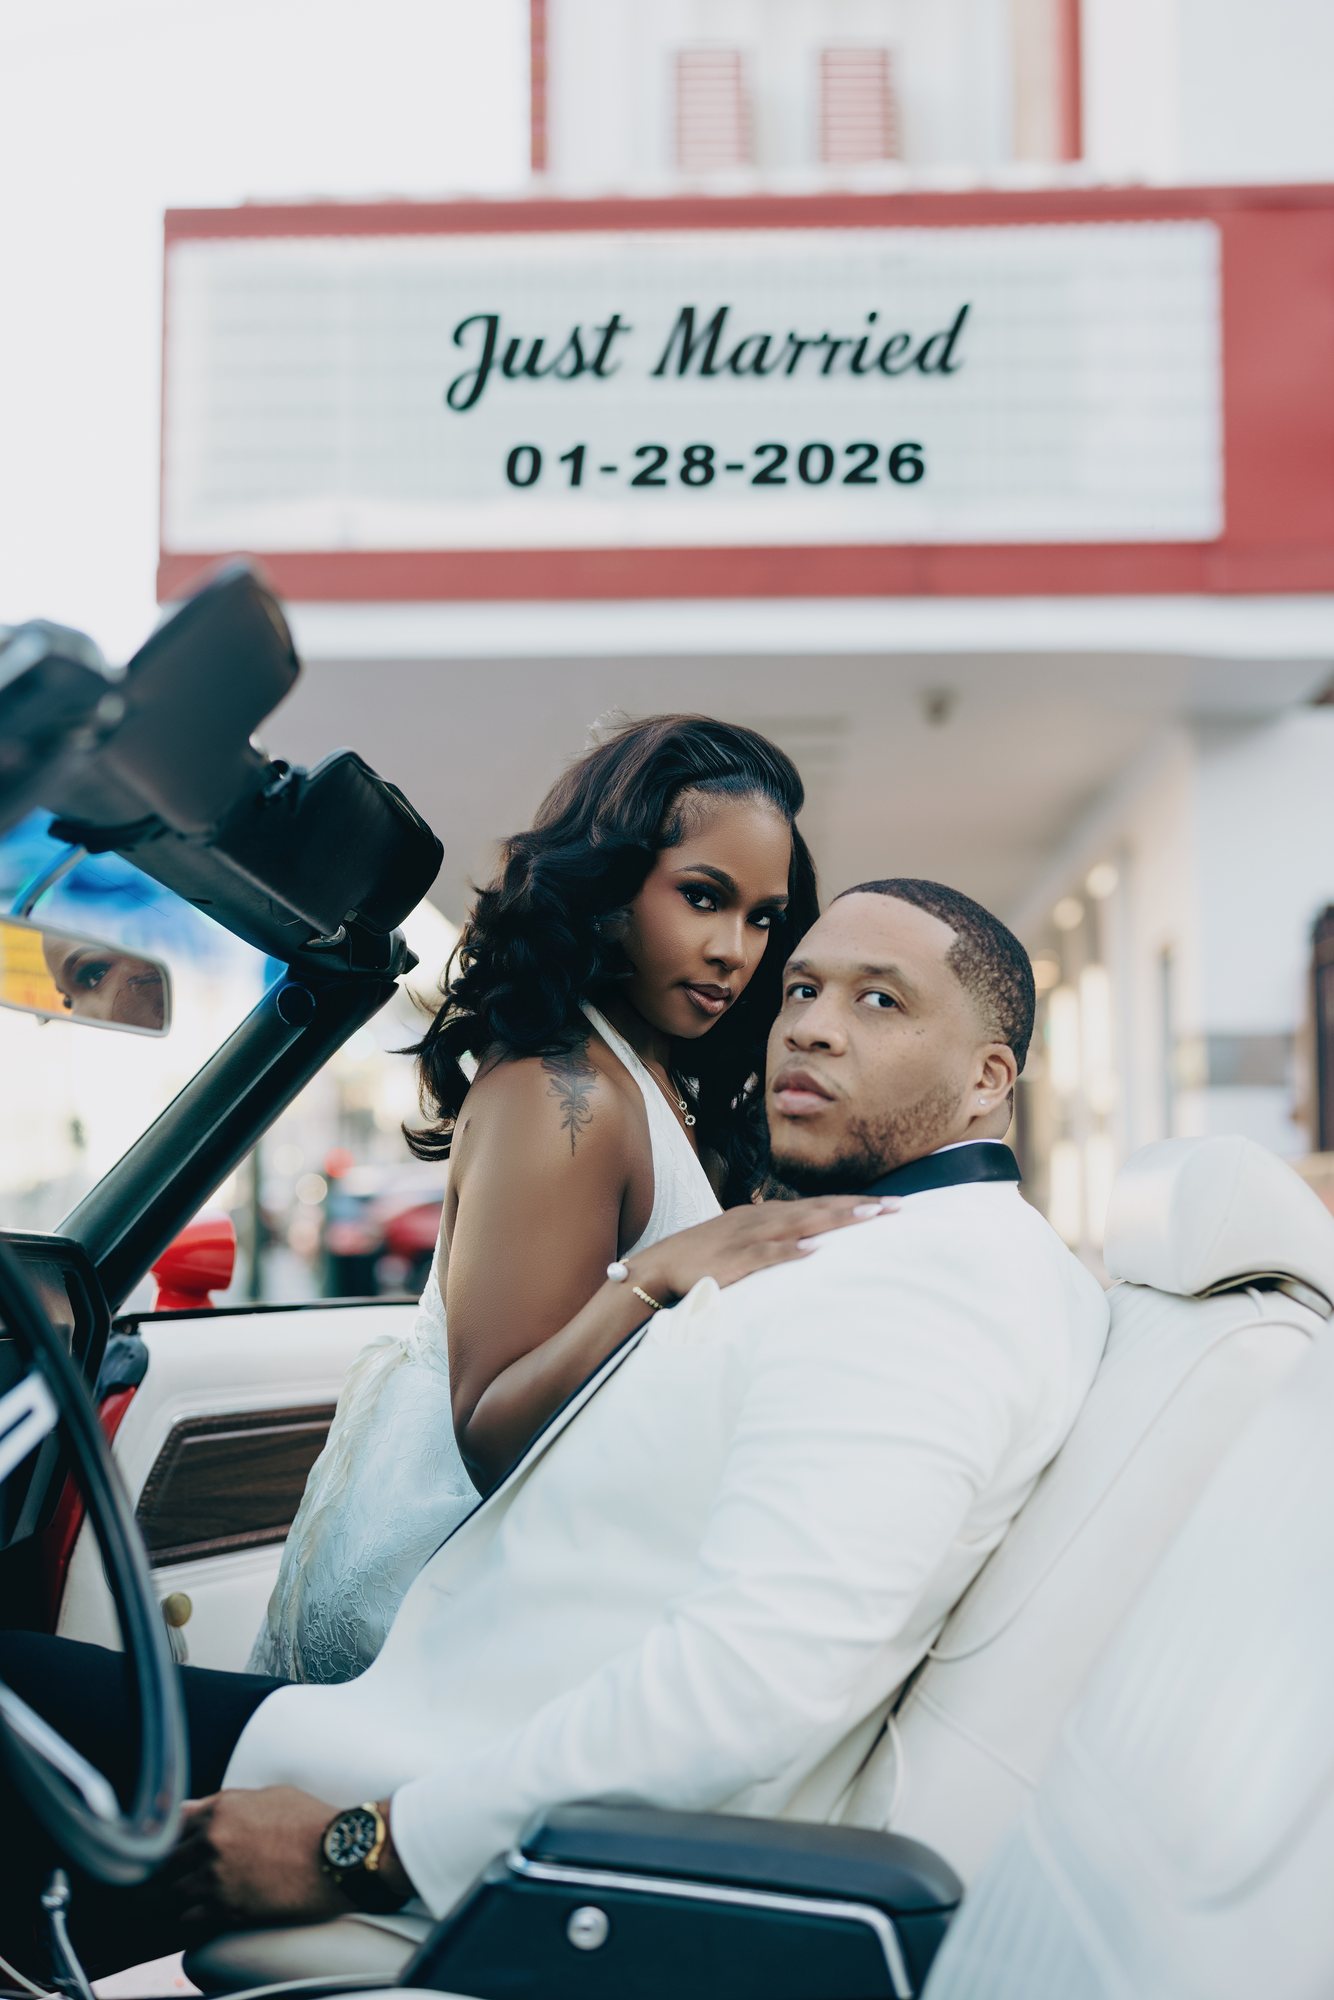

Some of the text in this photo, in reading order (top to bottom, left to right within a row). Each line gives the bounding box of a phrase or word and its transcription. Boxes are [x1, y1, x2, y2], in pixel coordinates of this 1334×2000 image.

[445, 303, 971, 413] Just Married
[505, 442, 926, 488] 01-28-2026
